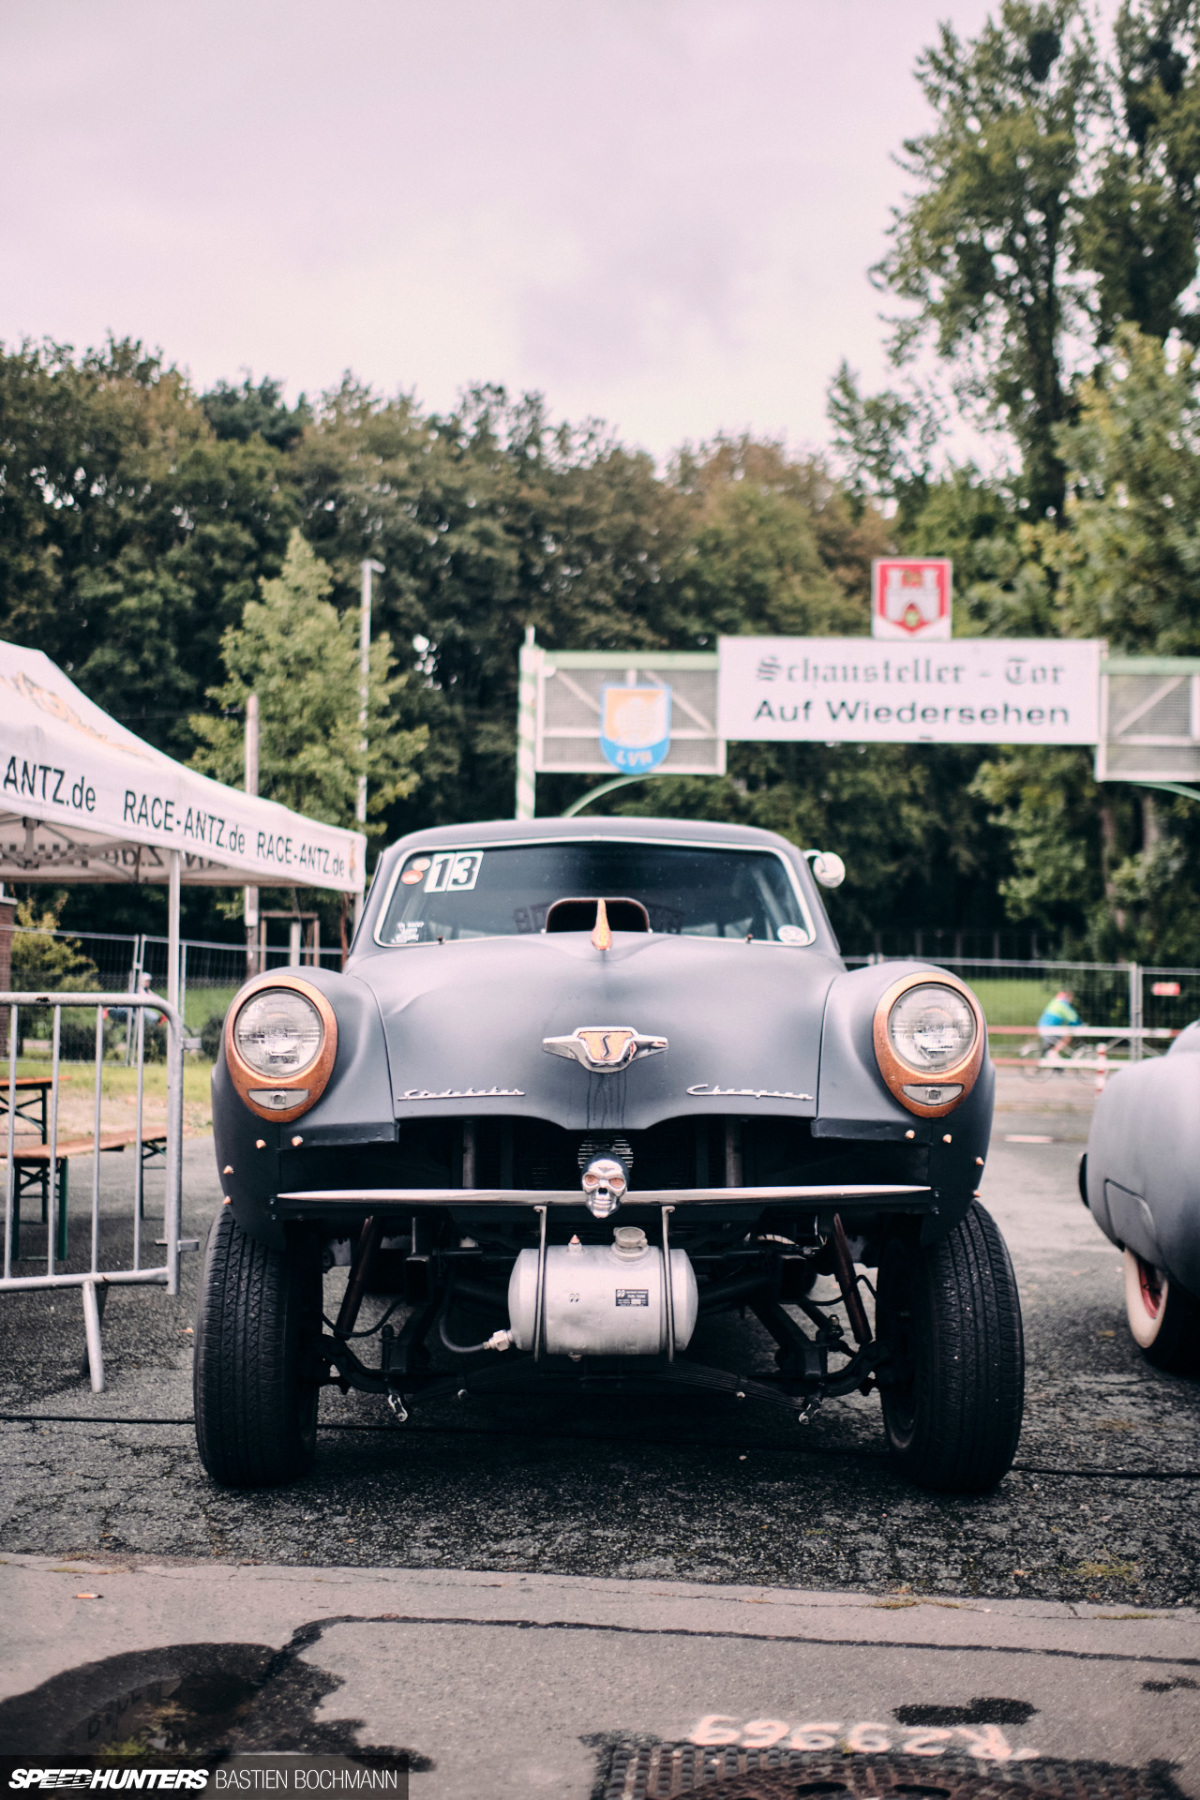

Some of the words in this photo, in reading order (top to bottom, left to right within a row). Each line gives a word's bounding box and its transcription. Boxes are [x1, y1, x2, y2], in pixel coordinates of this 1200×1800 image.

[756, 656, 965, 687] Schausteller
[1005, 657, 1064, 685] Tor
[754, 699, 813, 722] Auf
[825, 699, 1069, 725] Wiedersehen
[3, 756, 96, 812] ANTZ.de
[123, 790, 246, 854] RACE-ANTZ.de
[256, 831, 345, 877] RACE-ANTZ.de
[434, 856, 478, 888] 13
